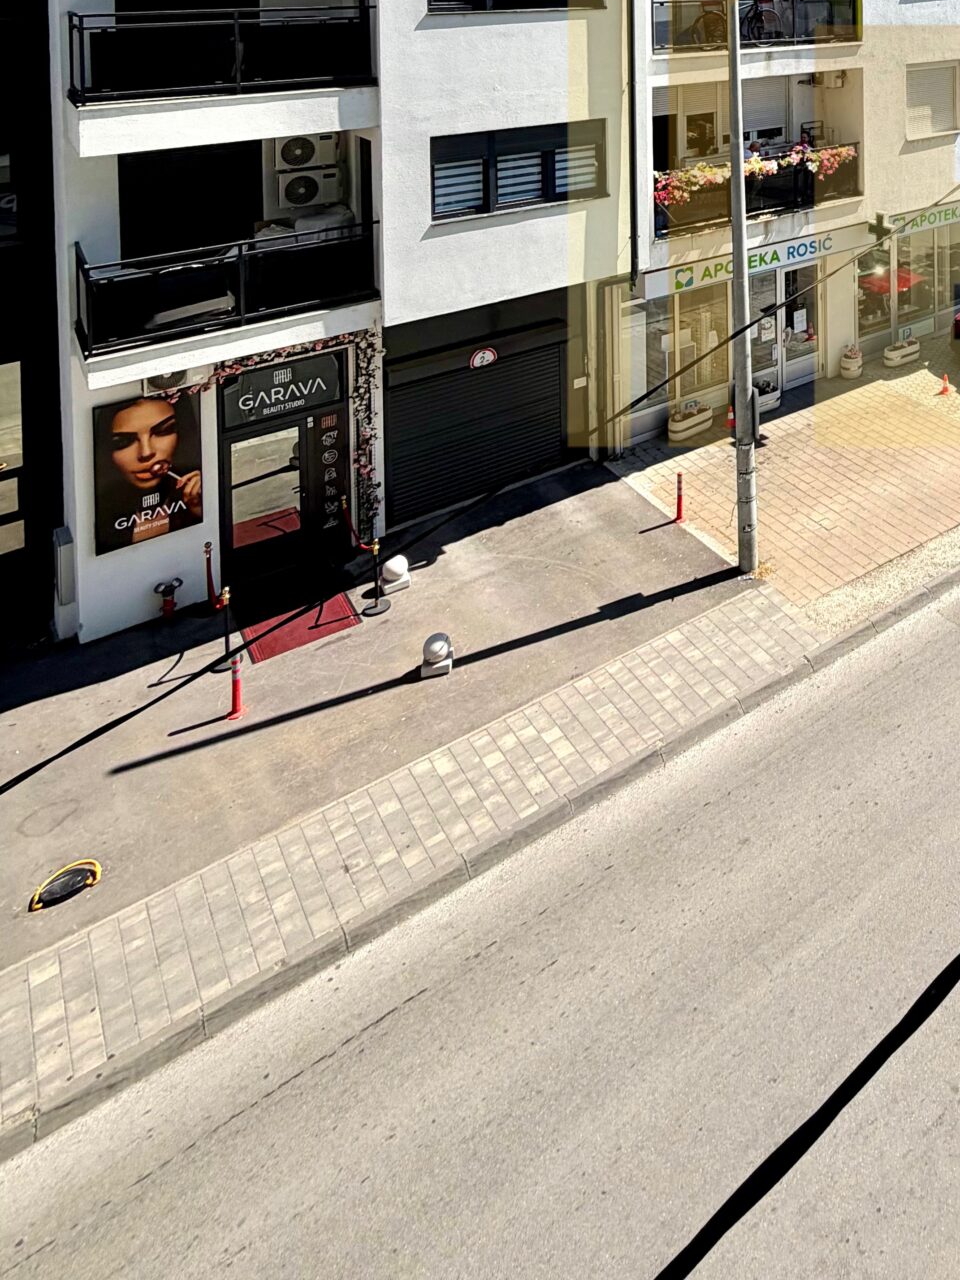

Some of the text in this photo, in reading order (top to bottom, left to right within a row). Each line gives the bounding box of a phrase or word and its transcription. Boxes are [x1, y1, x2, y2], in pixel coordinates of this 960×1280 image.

[700, 234, 833, 282] APOEKA ROSIĆ
[239, 377, 327, 410] GARAVA
[262, 398, 305, 416] BEAUTY STUDIO
[114, 500, 187, 530] GARAVA
